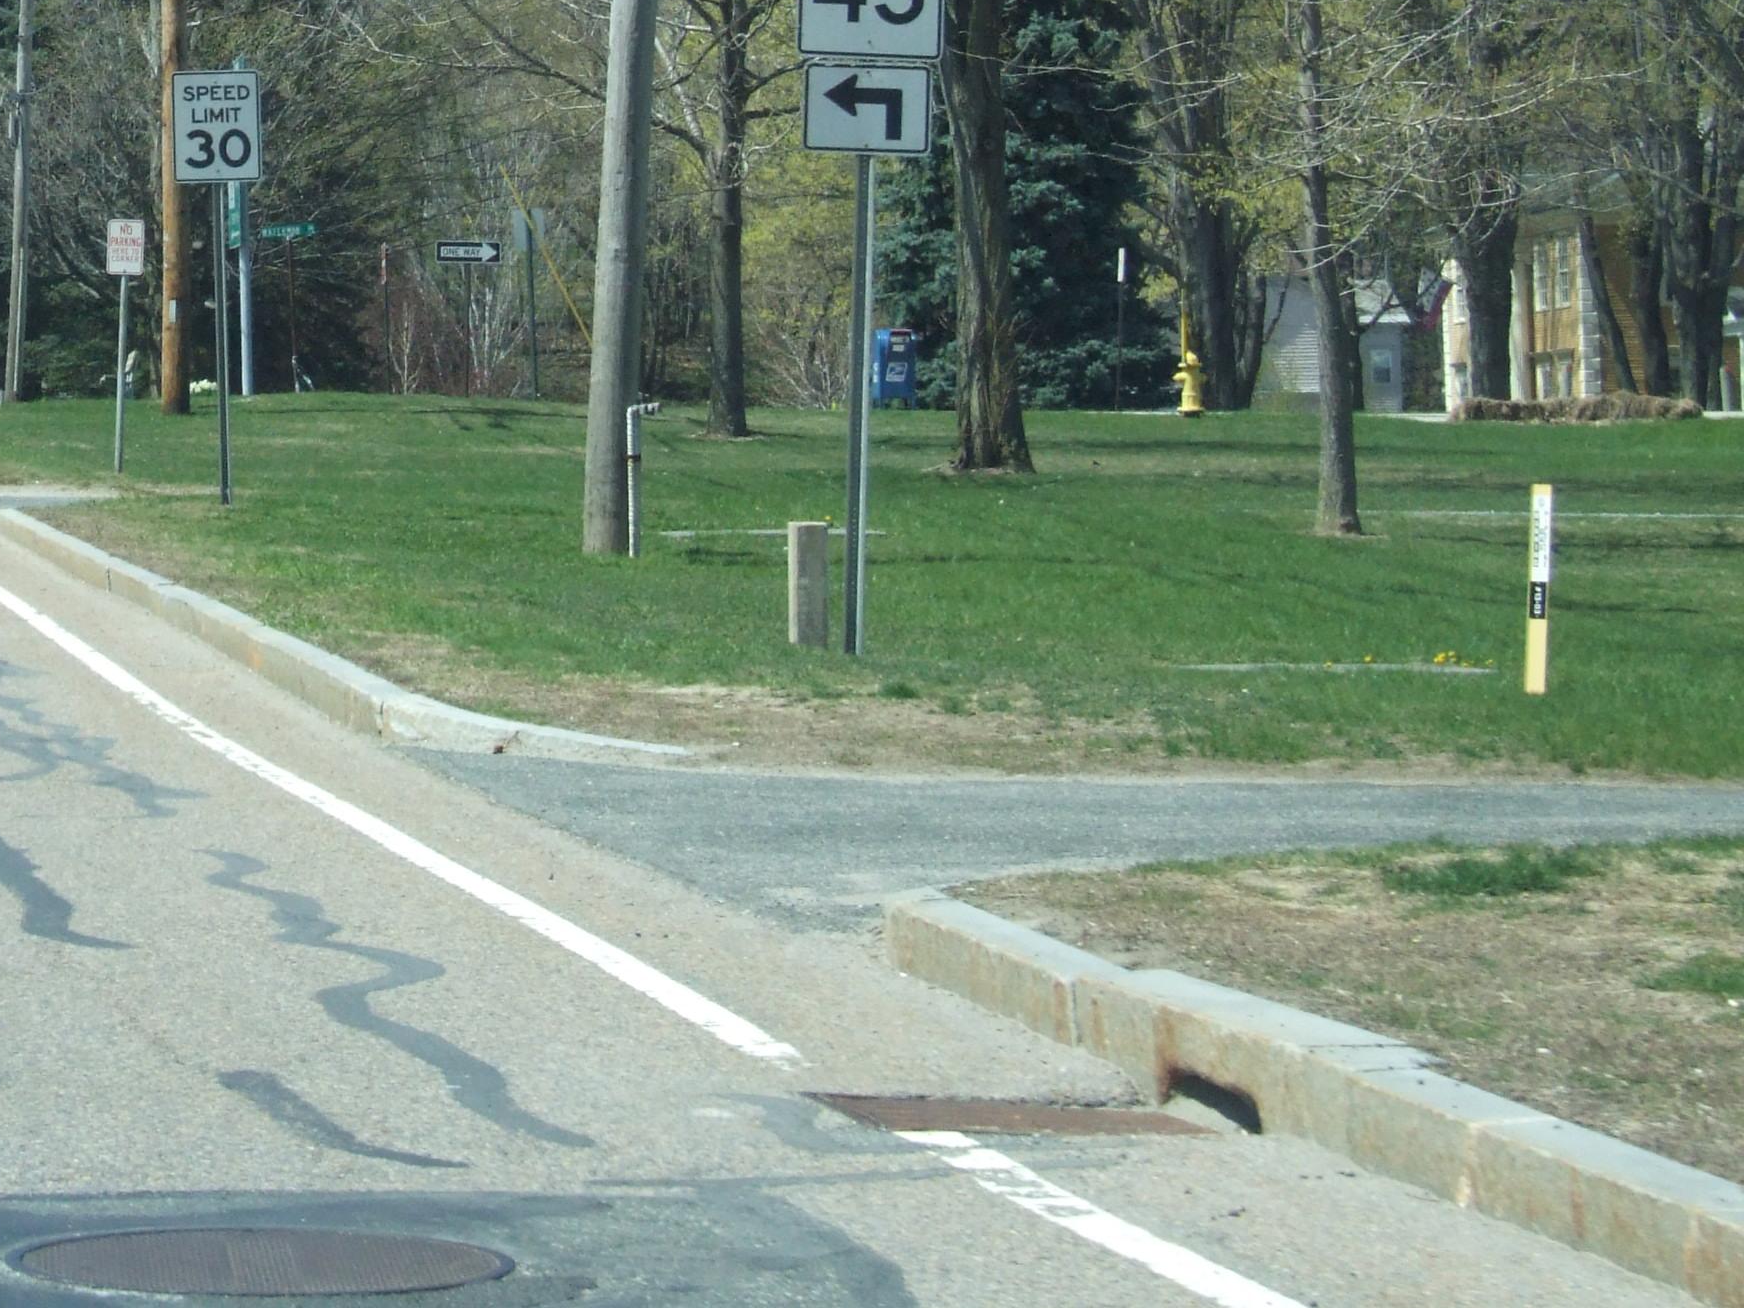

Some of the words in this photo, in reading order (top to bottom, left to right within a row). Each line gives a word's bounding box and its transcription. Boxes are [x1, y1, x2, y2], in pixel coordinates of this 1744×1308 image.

[183, 85, 250, 101] SPEED
[192, 107, 241, 123] LIMIT
[185, 128, 251, 169] 30
[120, 225, 132, 235] NO
[111, 237, 141, 247] PARKING
[442, 247, 461, 256] ONE
[463, 248, 481, 257] WAY
